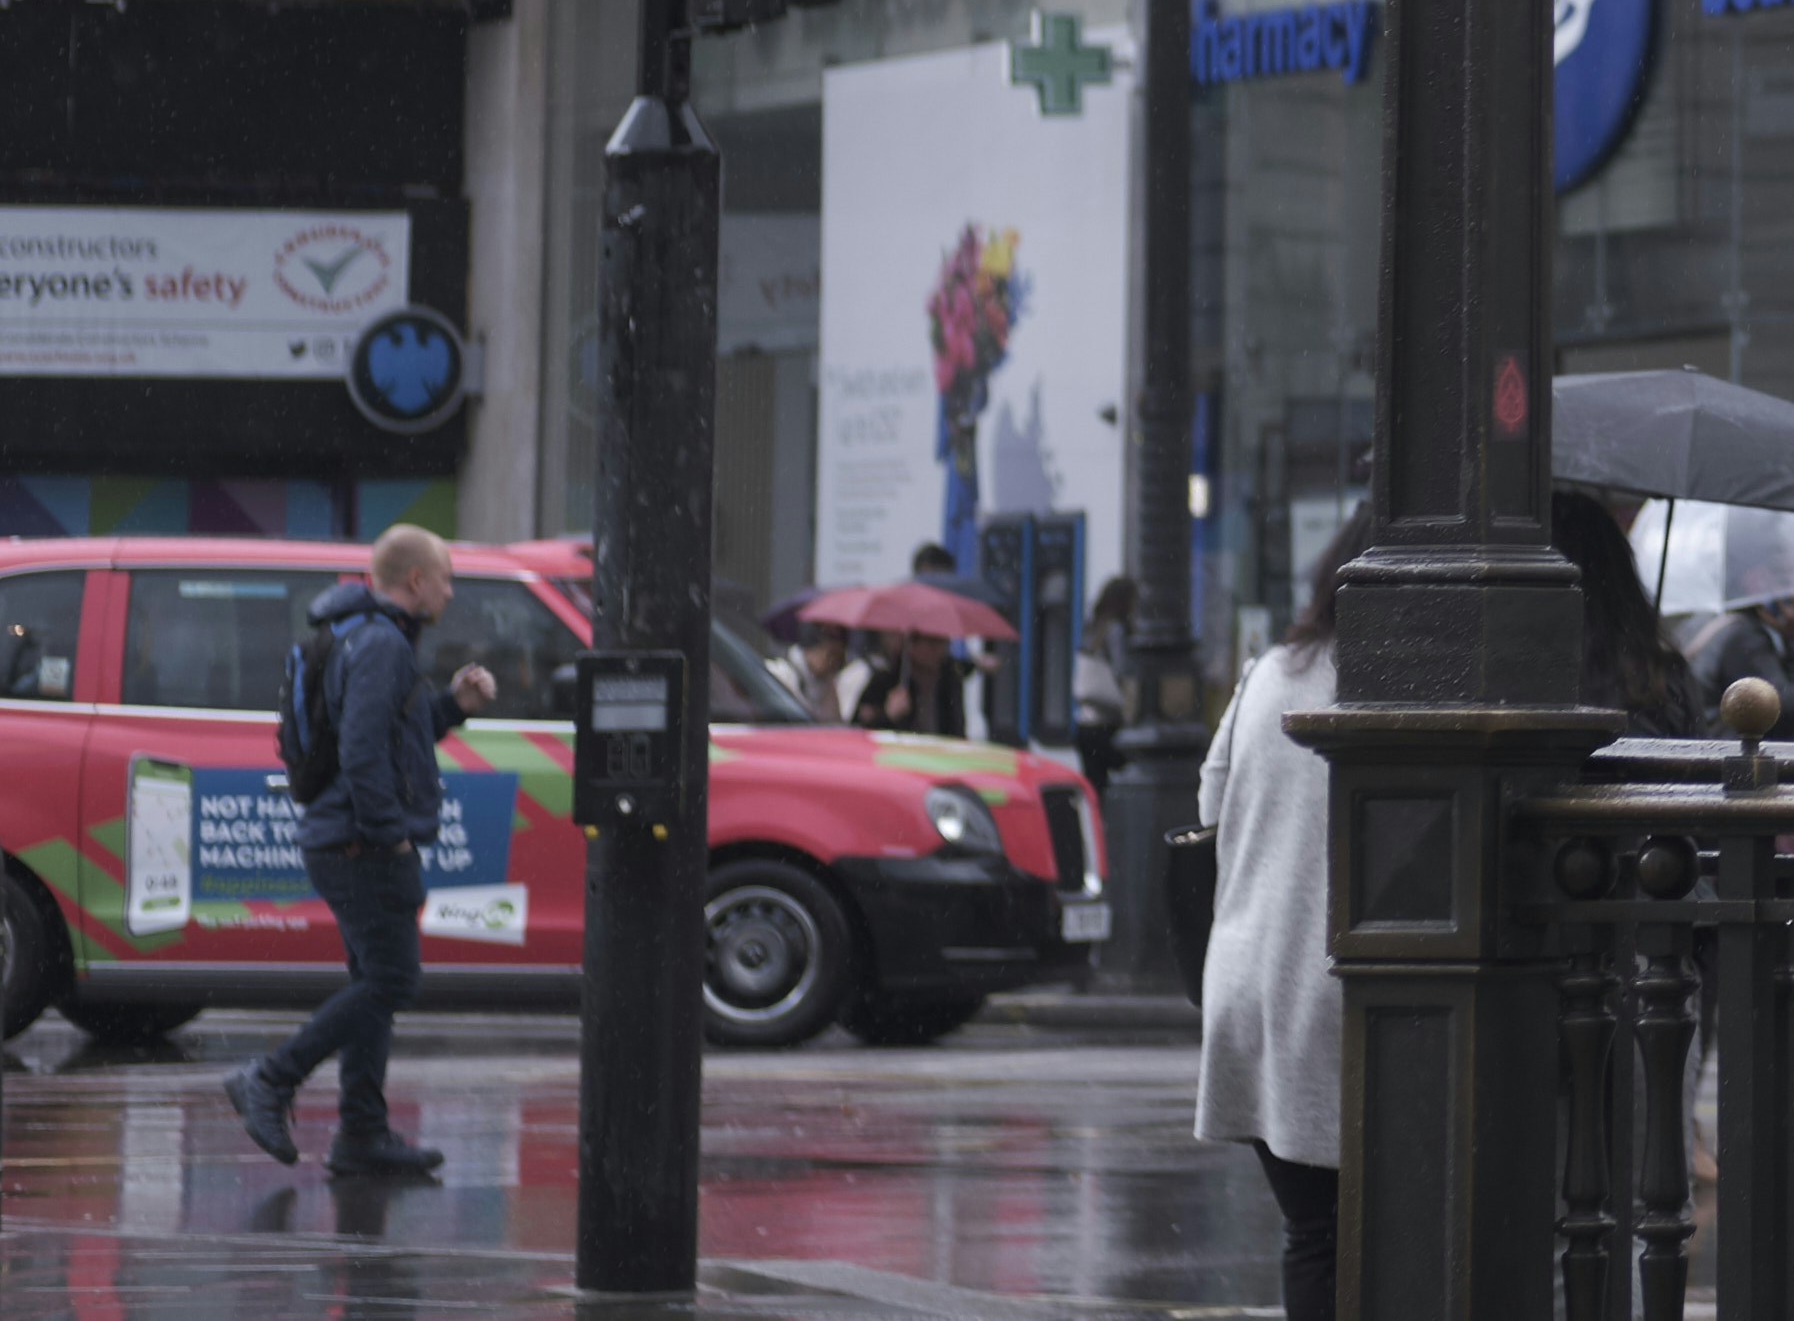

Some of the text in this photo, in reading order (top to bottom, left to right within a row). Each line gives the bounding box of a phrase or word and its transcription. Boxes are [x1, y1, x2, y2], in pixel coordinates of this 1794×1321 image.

[144, 265, 248, 310] safety
[200, 794, 306, 820] NOT HAV
[200, 818, 266, 844] BACK
[199, 843, 306, 871] MACHIN
[437, 846, 473, 872] UP
